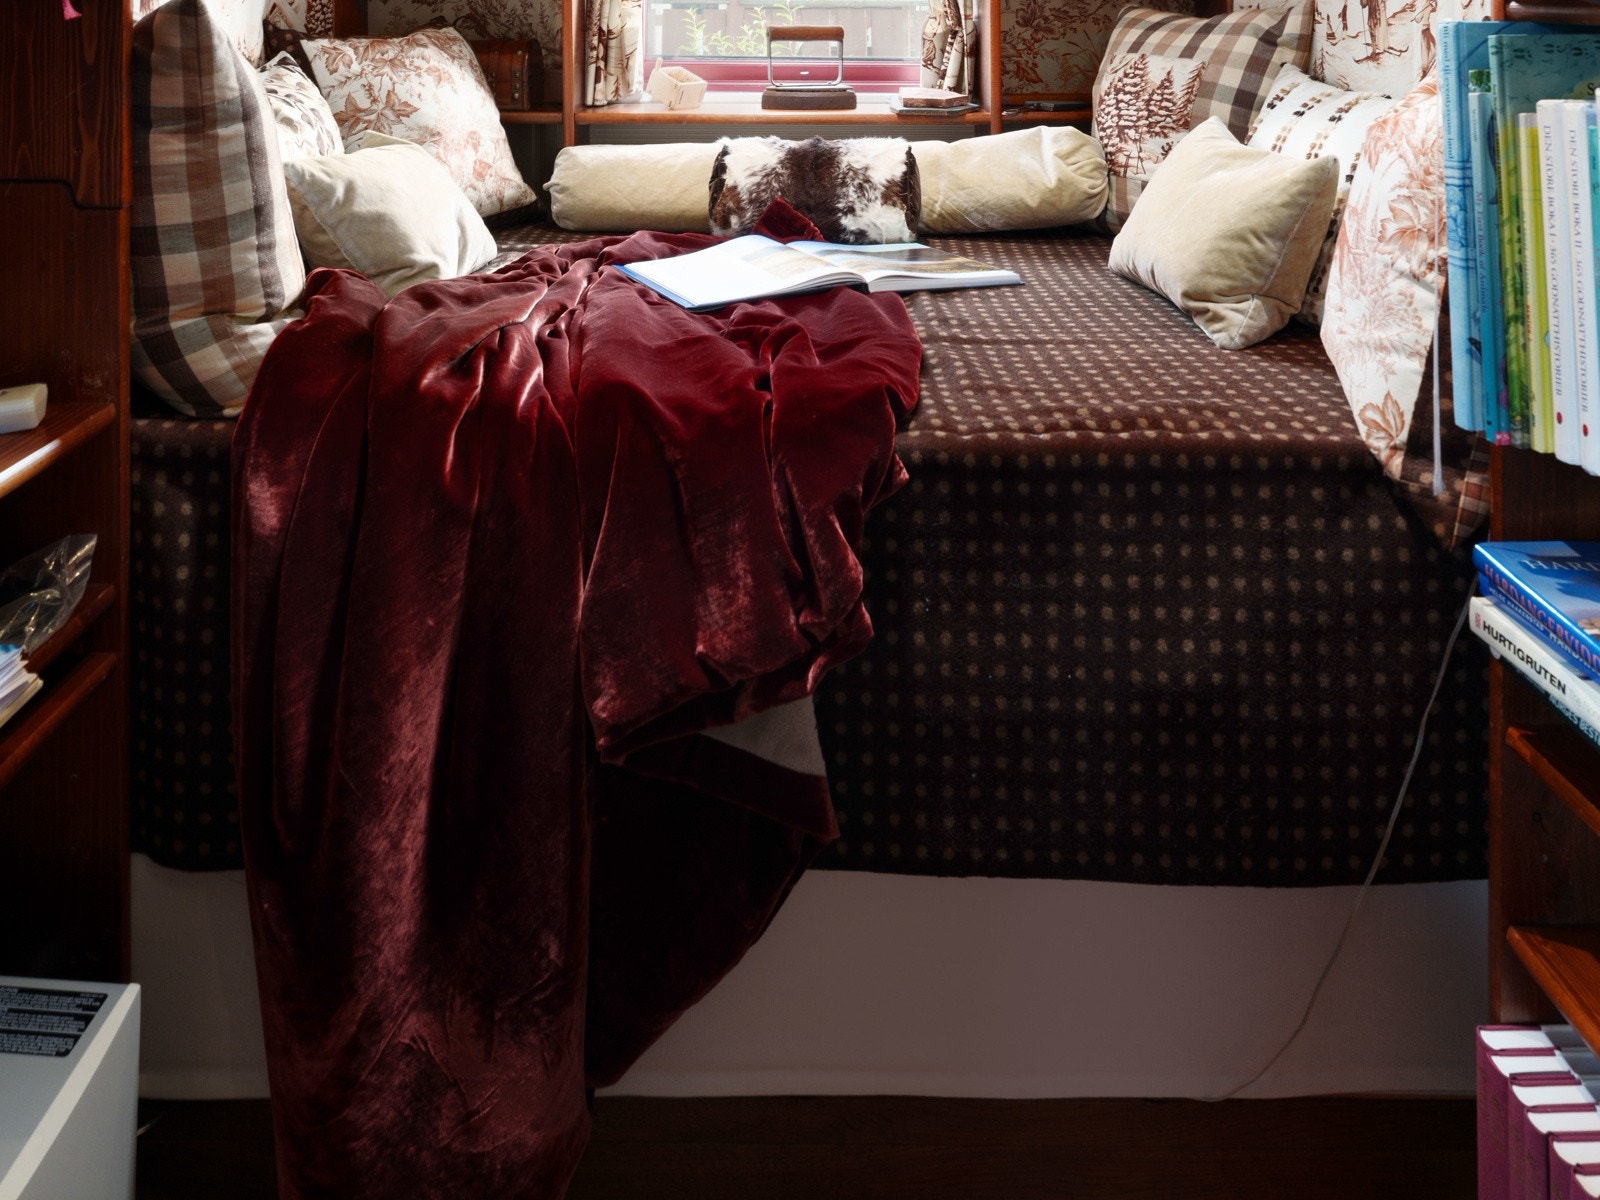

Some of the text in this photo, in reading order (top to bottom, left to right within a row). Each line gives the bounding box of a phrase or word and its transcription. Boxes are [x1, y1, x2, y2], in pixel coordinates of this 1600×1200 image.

[1543, 125, 1553, 153] DEN
[1568, 129, 1578, 157] DEN
[1545, 154, 1555, 192] STORE
[1570, 159, 1580, 197] STORE
[1547, 195, 1556, 230] BOKA
[1573, 202, 1582, 237] BOKA
[1550, 247, 1558, 266] 365
[1575, 260, 1584, 278] 365
[1551, 267, 1562, 397] GODNATTHISTORIER
[1576, 280, 1588, 413] GODNATTHISTORIER
[1483, 620, 1567, 695] HURTIGRUTEN
